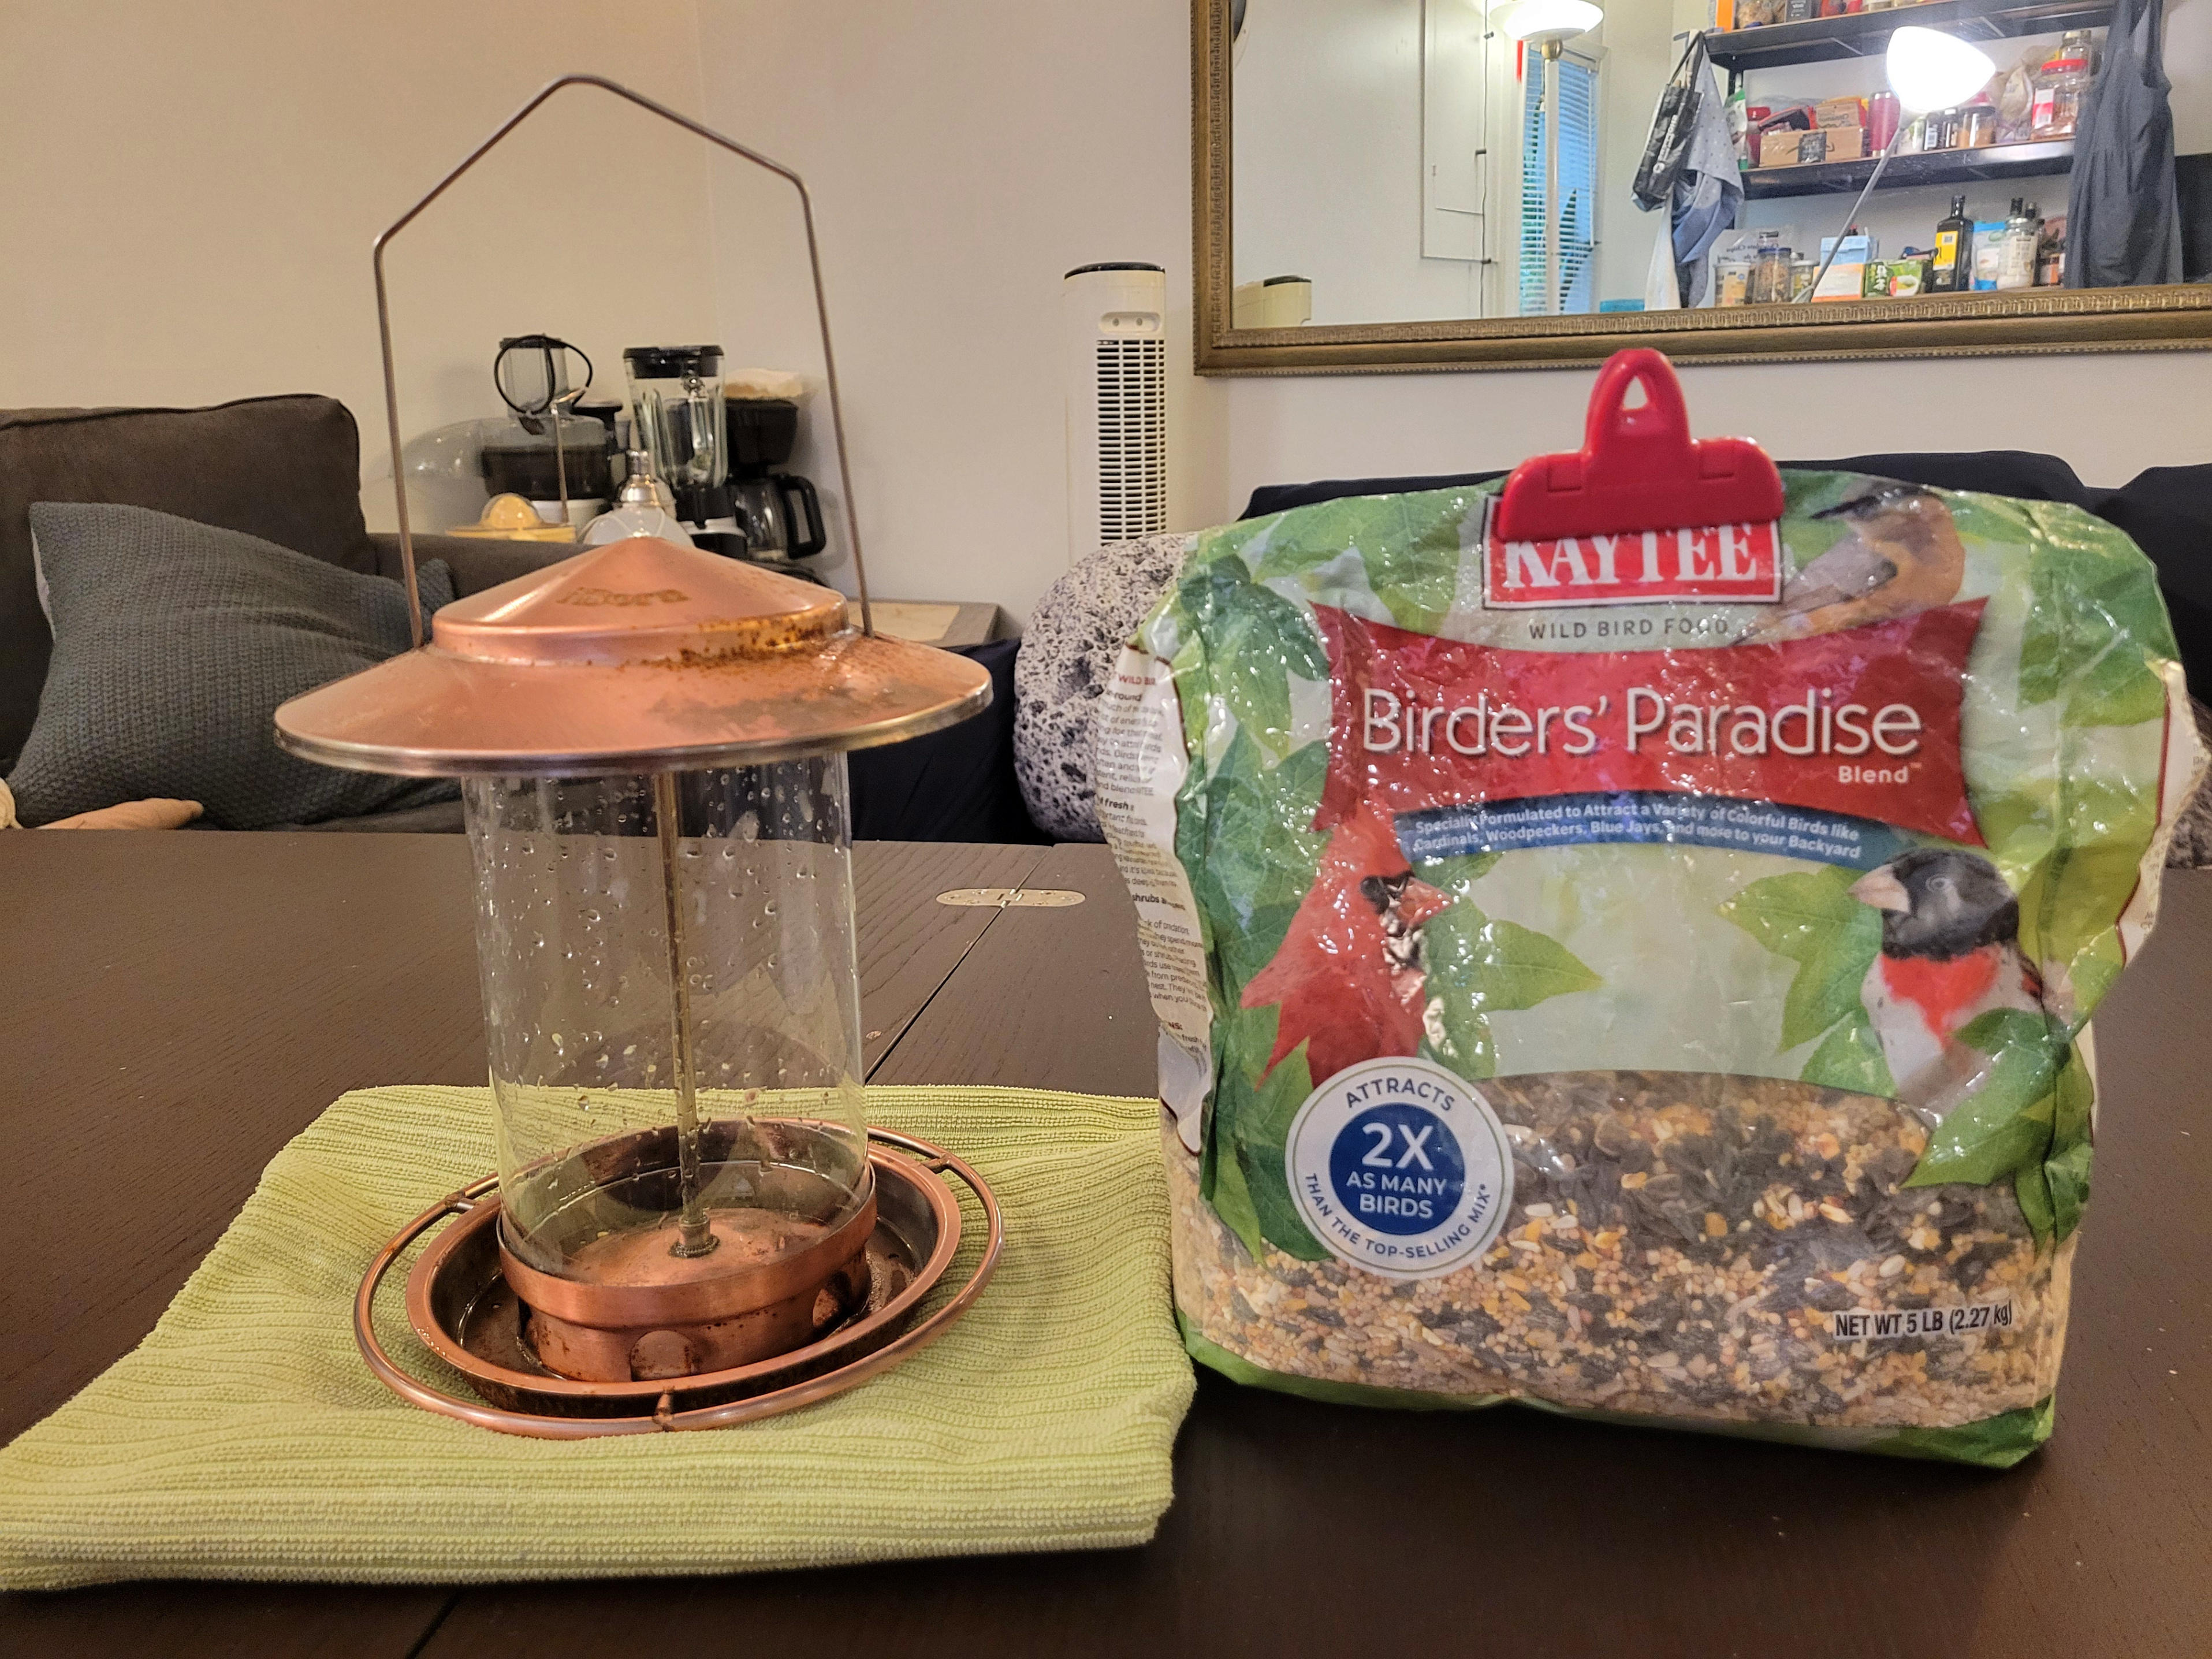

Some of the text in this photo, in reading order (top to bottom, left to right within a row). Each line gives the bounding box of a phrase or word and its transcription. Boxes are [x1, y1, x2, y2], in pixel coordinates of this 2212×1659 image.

[1502, 523, 1756, 588] KAYTEE
[1529, 617, 1728, 639] WILD BIRD FOOD
[1362, 687, 1922, 756] Birders' Paradise
[1480, 805, 1561, 826] Formulated
[1565, 808, 1581, 819] to
[1584, 804, 1638, 817] Attract
[1641, 805, 1650, 815] a
[1652, 803, 1707, 821] Variety
[1710, 806, 1726, 820] of
[1726, 806, 1785, 829] Colorful
[1788, 817, 1829, 836] Birds
[1831, 824, 1860, 842] like
[1591, 821, 1624, 834] Blue
[1696, 825, 1733, 839] more
[1734, 827, 1751, 841] to
[1752, 832, 1786, 847] your
[1788, 835, 1861, 859] Backyard
[1174, 995, 1188, 1003] you
[1345, 1077, 1455, 1111] ATTRACTS
[1361, 1122, 1434, 1170] 2X
[1346, 1170, 1448, 1196] AS MANY
[1305, 1173, 1333, 1217] THAN
[1331, 1217, 1361, 1245] THE
[1365, 1225, 1472, 1258] TOP-SELLING
[1359, 1193, 1433, 1219] BIRDS
[1835, 1299, 2012, 1337] NET WT 5 LB (2.27 kg)
